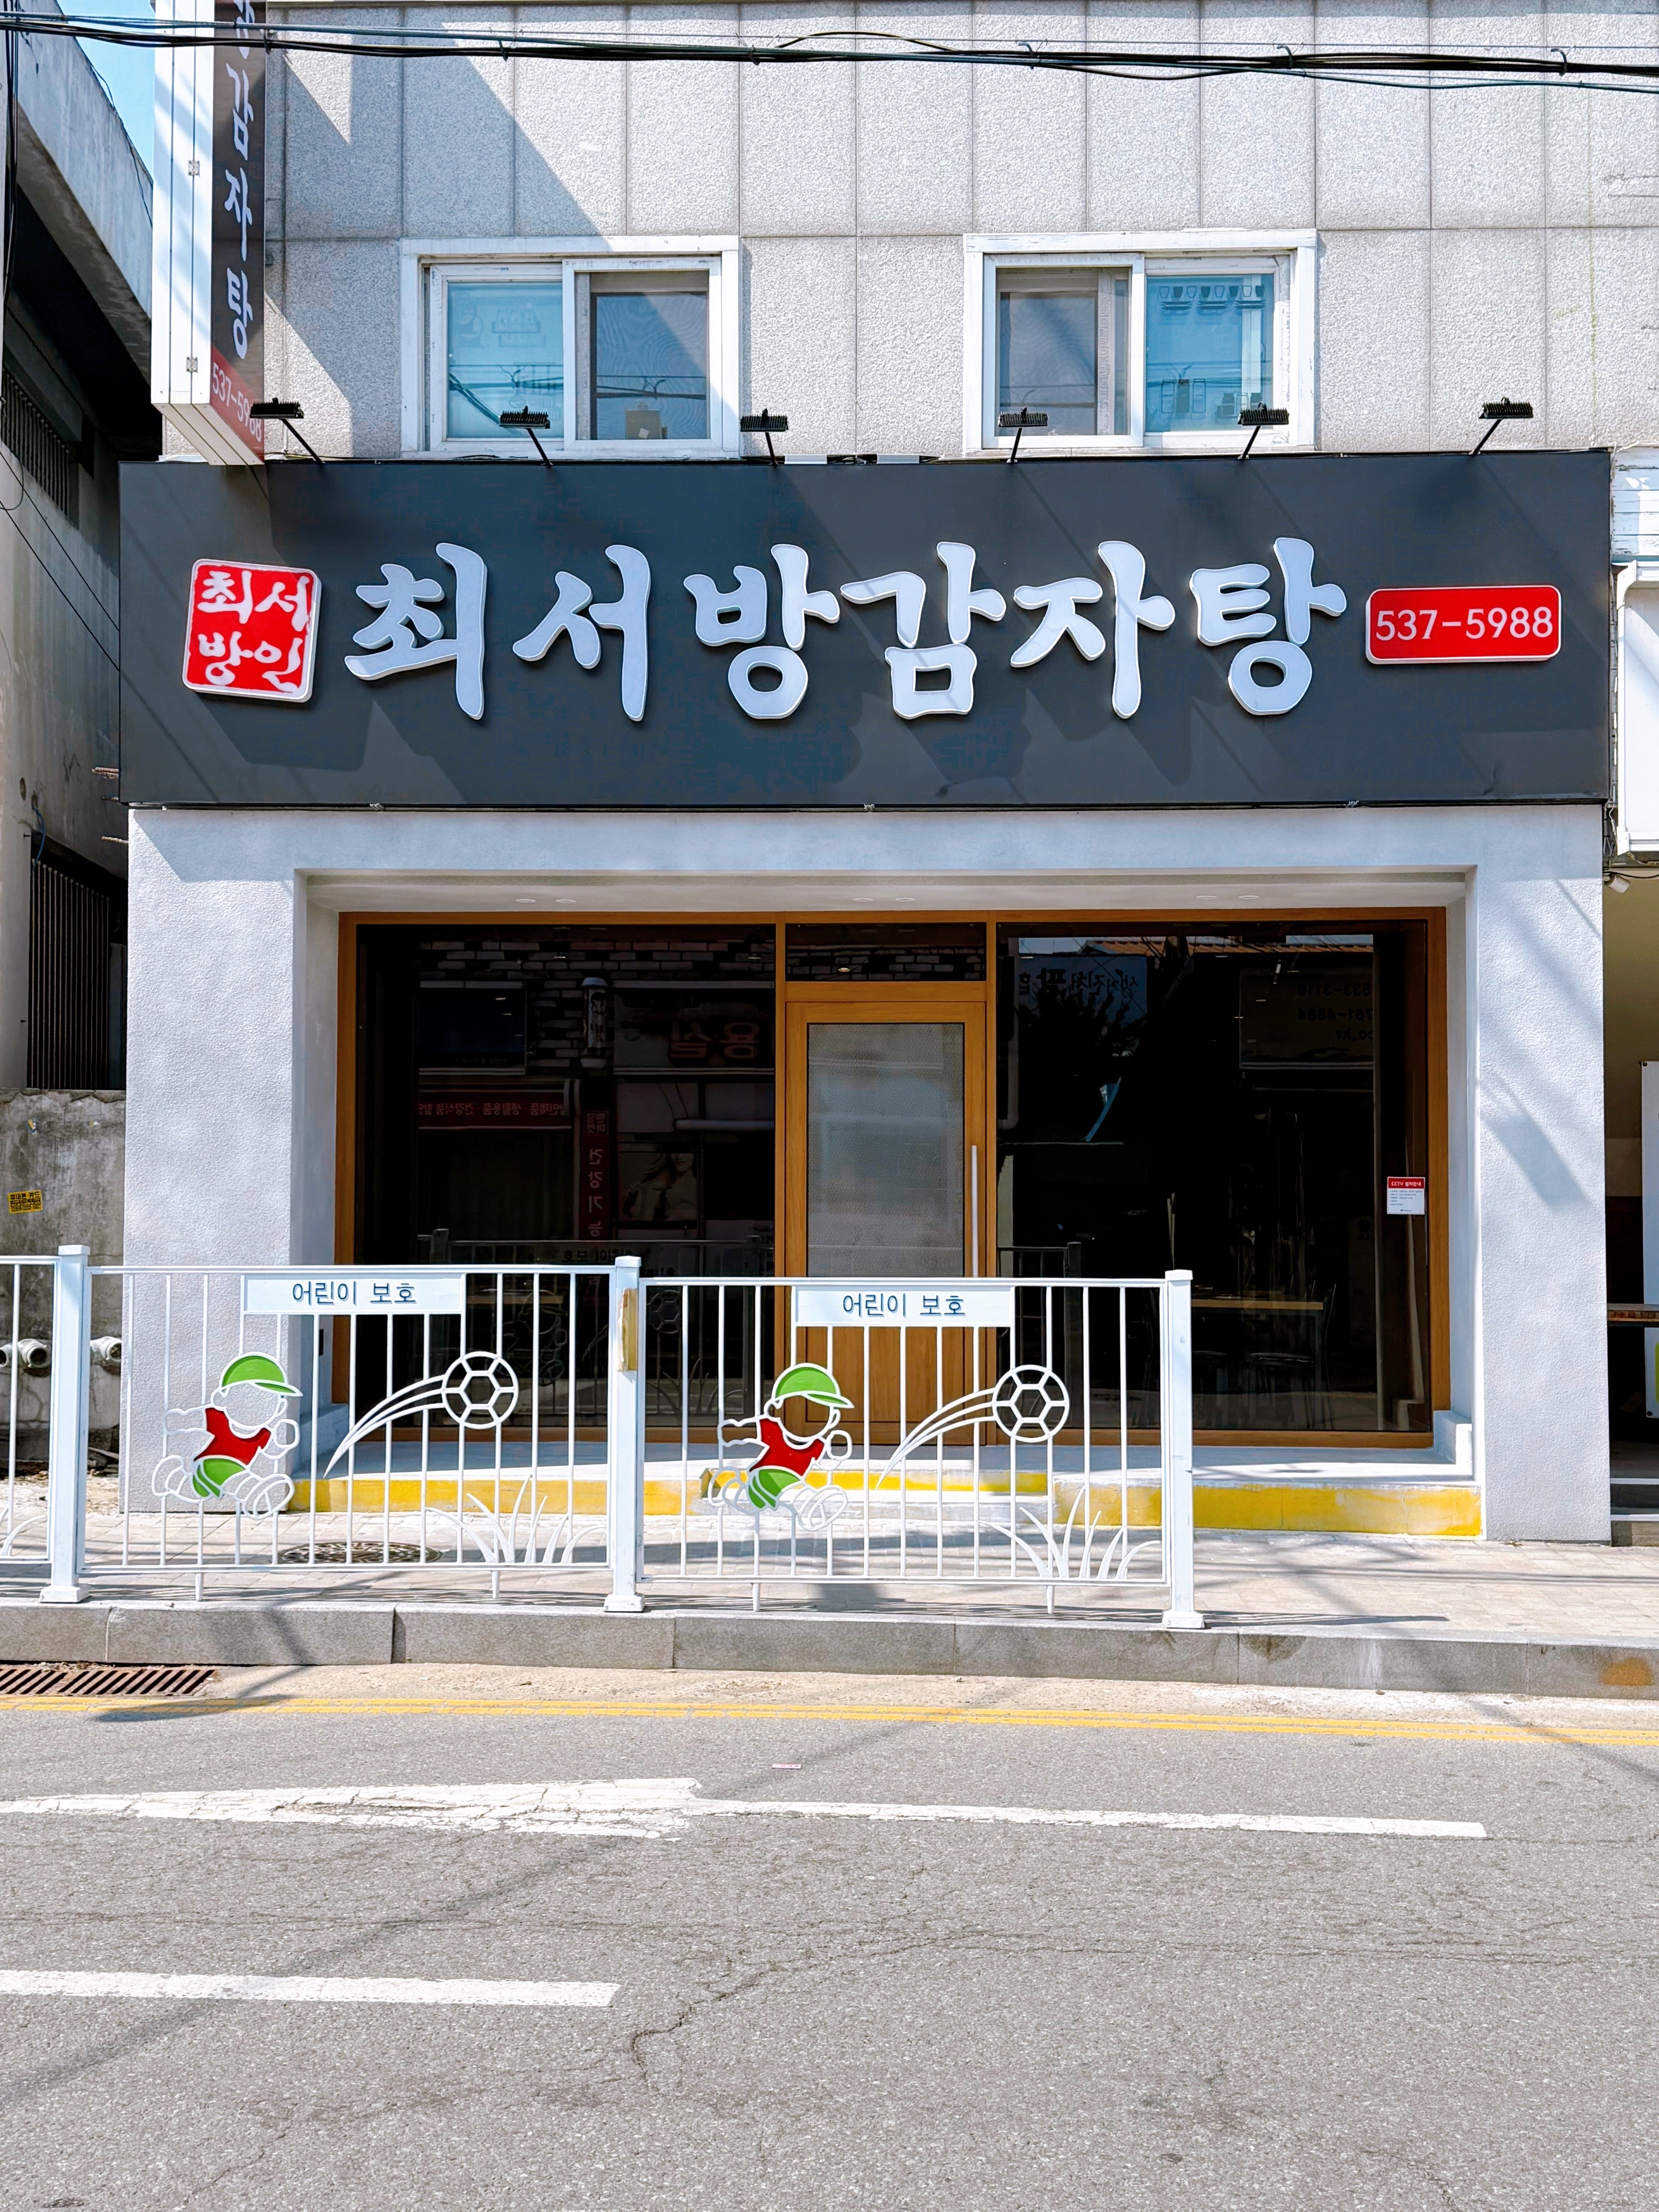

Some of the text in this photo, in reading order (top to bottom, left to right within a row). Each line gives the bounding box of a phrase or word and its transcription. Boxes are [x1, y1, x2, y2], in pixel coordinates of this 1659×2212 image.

[1375, 606, 1554, 641] 537-5988
[292, 1281, 417, 1305] 어린이 보호
[842, 1292, 966, 1318] 어린이 보호
